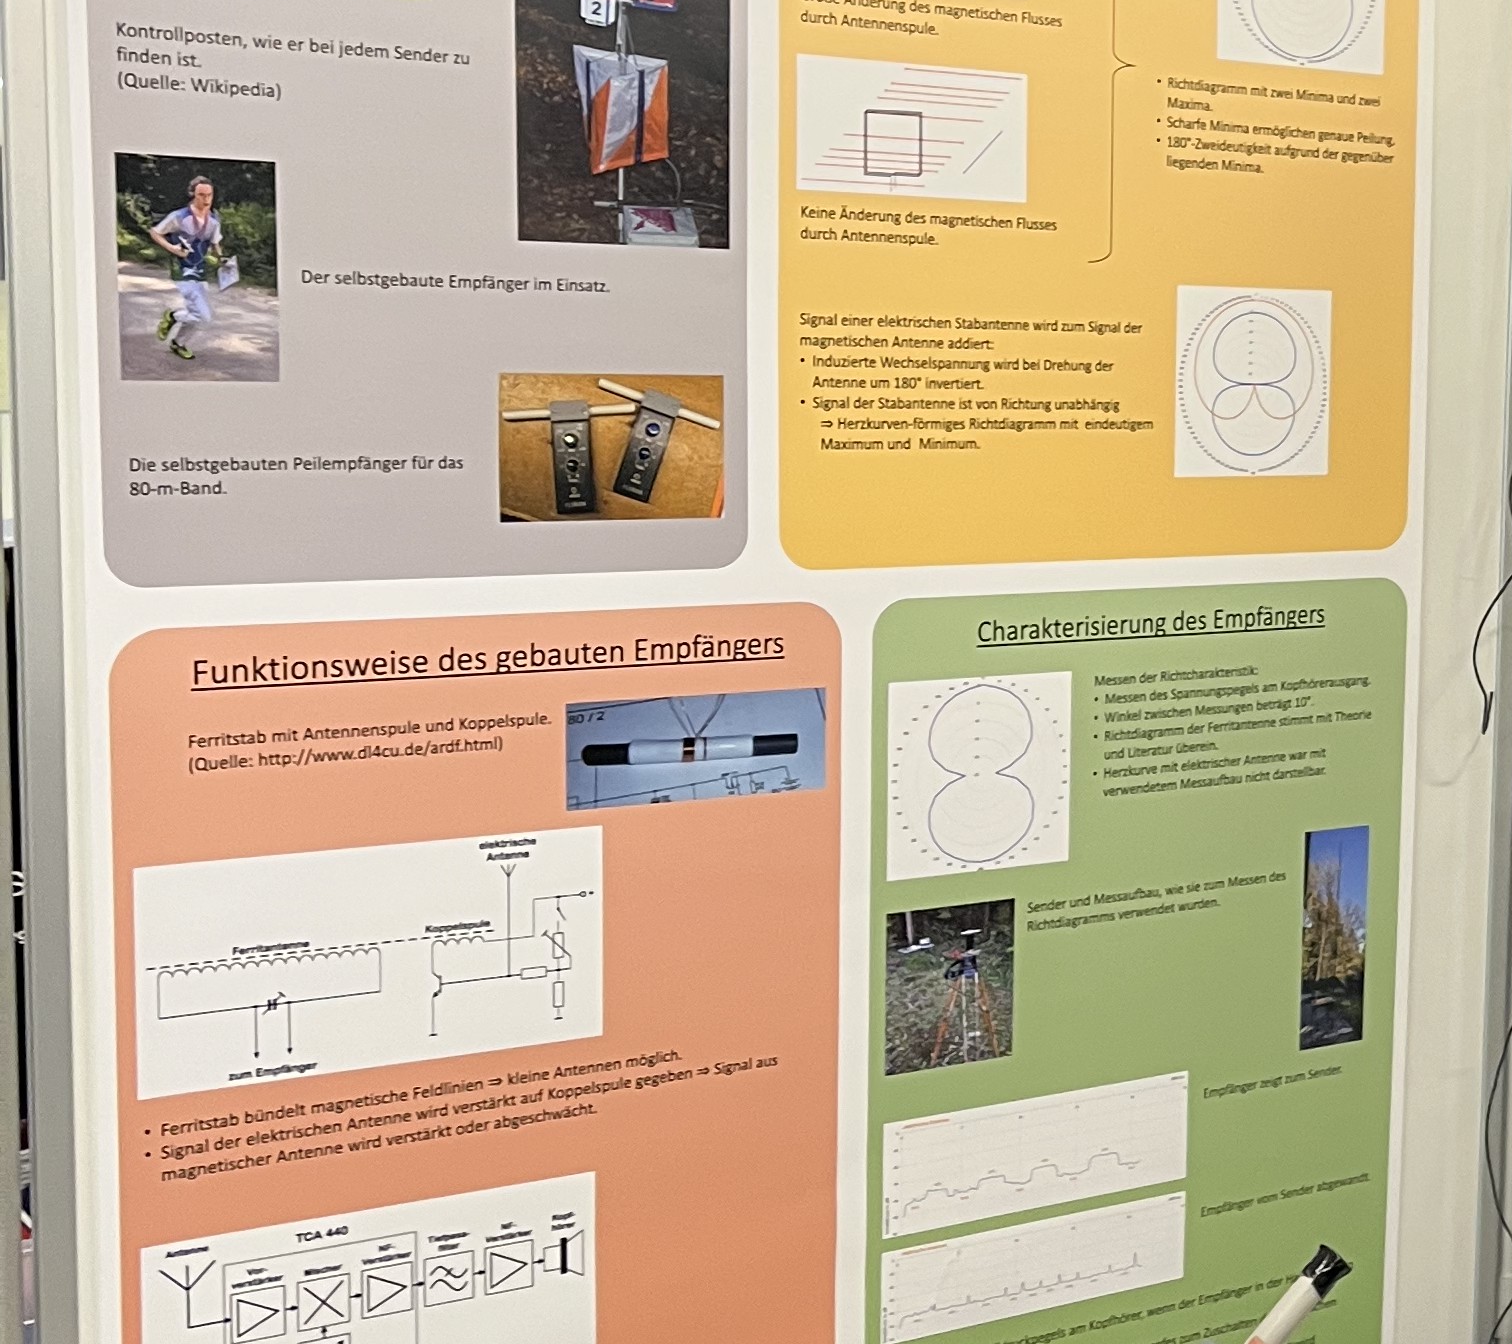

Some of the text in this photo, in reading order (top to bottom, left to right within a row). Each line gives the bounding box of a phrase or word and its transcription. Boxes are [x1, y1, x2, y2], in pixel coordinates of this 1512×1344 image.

[591, 1, 602, 16] 2
[909, 0, 931, 13] des
[934, 4, 1017, 22] magnetischen
[1021, 11, 1062, 27] Flusses
[800, 9, 939, 35] durch Antennenspule.
[116, 21, 469, 65] Kontrollposten, wie er bei jedem Sender zu
[116, 45, 201, 67] finden ist.
[117, 71, 281, 101] (Quelle: Wikipedia)
[301, 269, 610, 293] Der selbstgebaute Empfänger im Einsatz.
[799, 312, 1143, 335] Signal einer elektrischen Stabantenne wird zum Signal der
[129, 455, 463, 474] Die selbstgebauten Peilempfänger für das
[129, 480, 227, 496] 80-m-Band.
[977, 606, 1325, 643] Charakterisierung des Empfängers
[193, 635, 784, 688] Funktionsweise des gebauten Empfängers
[188, 711, 551, 748] Ferritstab mit Antennenspule und Koppelspule.
[188, 754, 253, 774] (Quelle:
